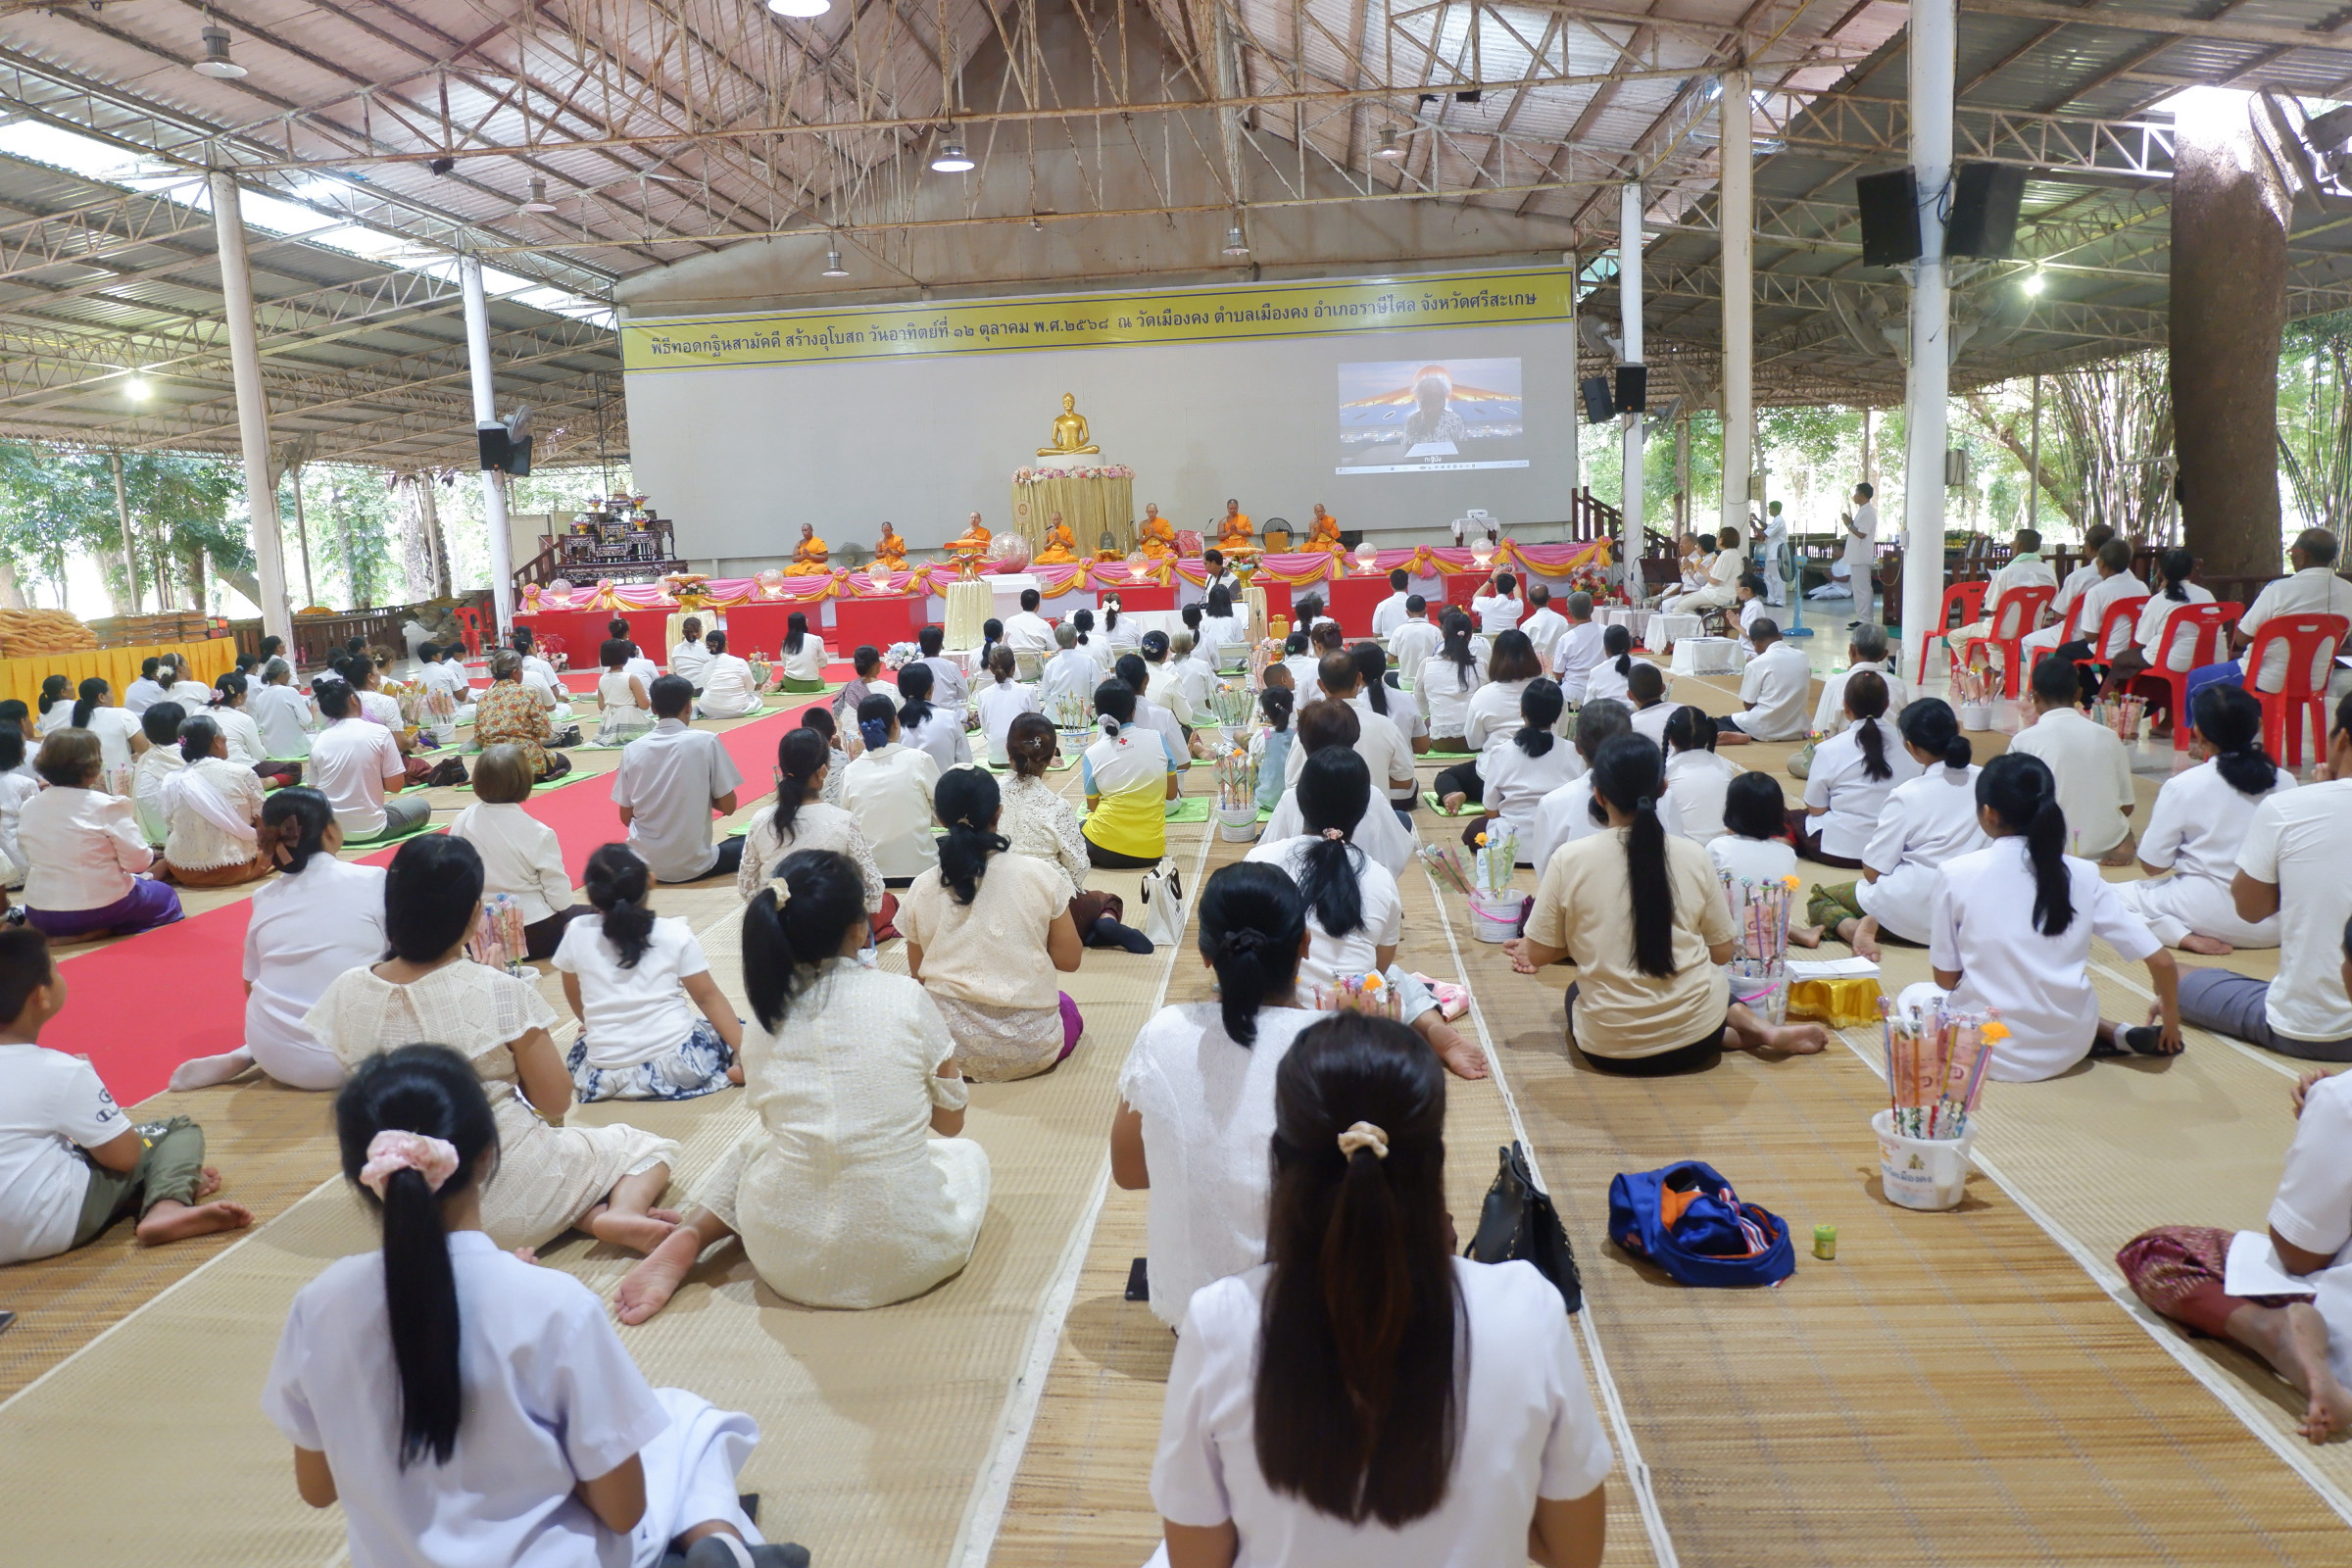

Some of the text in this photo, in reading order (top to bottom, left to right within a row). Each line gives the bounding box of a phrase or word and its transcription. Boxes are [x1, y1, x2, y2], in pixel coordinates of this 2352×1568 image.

[651, 289, 1538, 358] พิธีทอดกฐินสามัคคี สร้างอุโบสถ วันอาทิตย์ที่ ๑๒ ตุลาคม พ.ศ.๒๕๖๘ ณ วัดเมืองคง ตำบลเมืองคง อำเภอราษีไศล จังหวัดศรีสะเกษ
